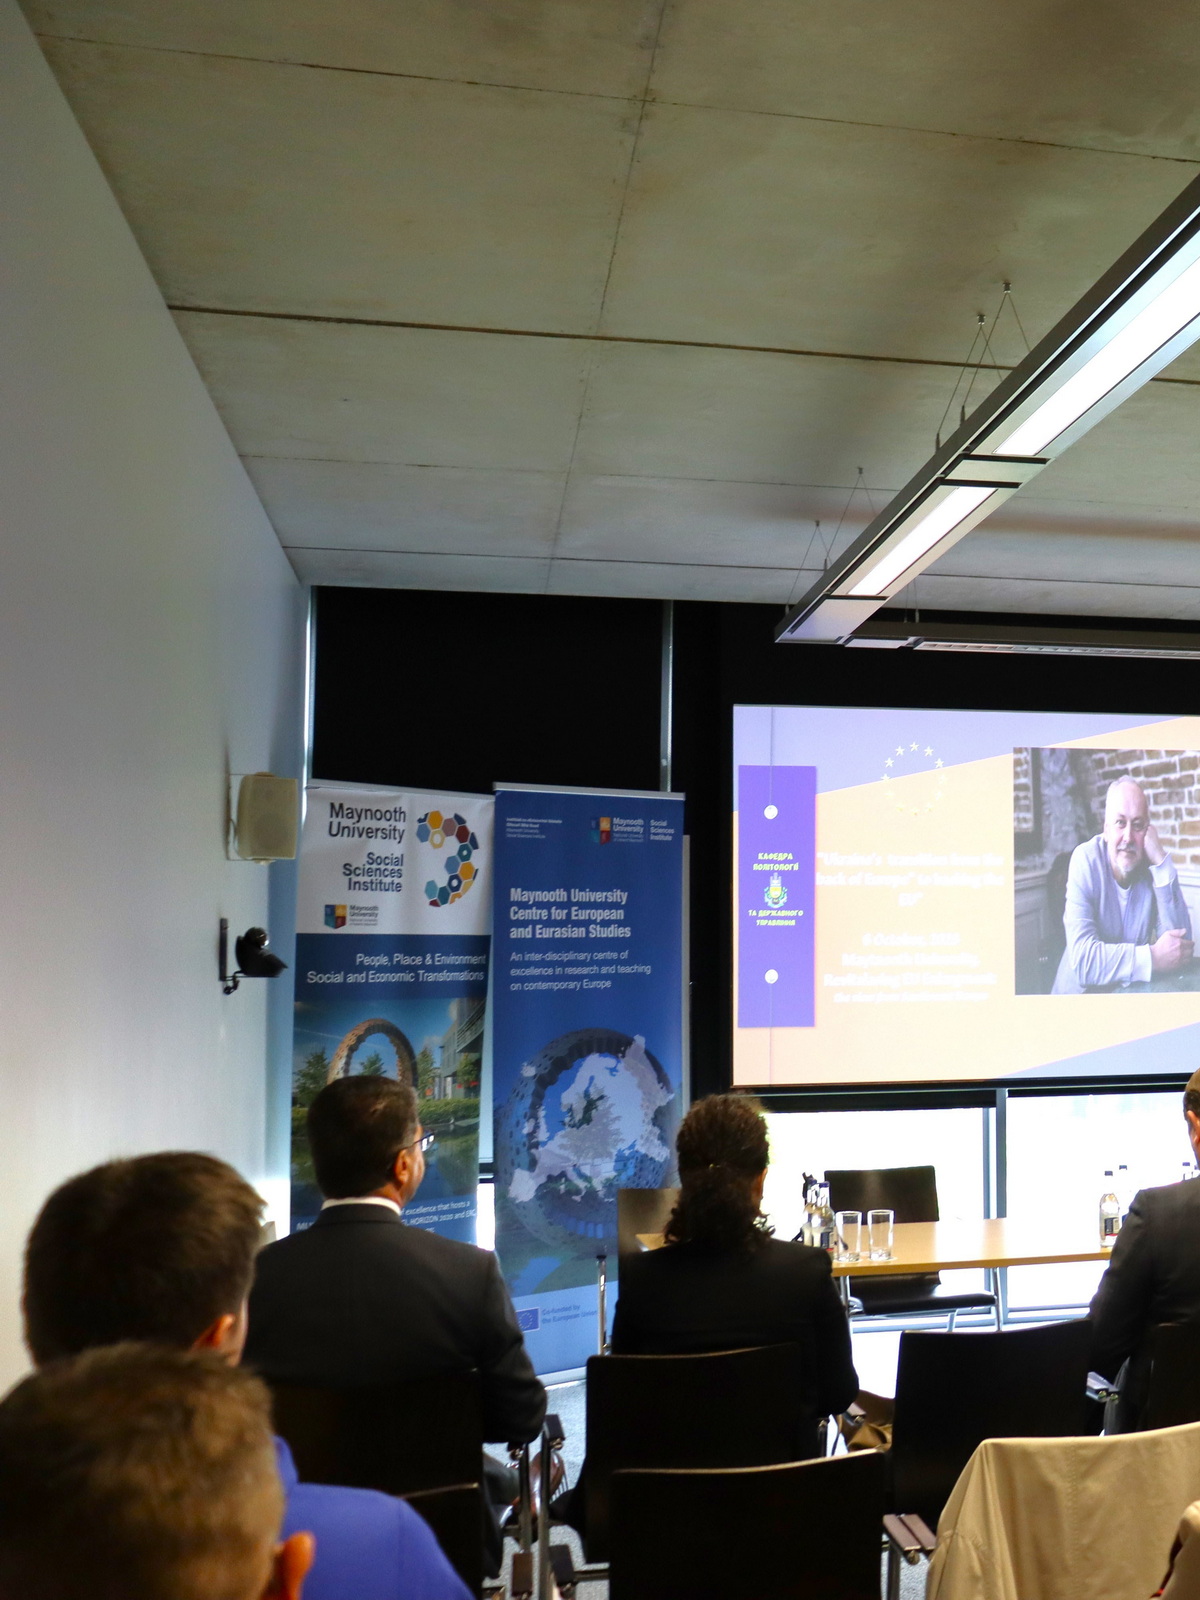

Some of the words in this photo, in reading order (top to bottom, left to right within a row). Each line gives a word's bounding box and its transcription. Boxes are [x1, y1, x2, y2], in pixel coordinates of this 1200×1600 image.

[330, 802, 406, 823] Maynooth
[613, 817, 644, 826] Maynooth
[650, 819, 668, 827] Social
[328, 821, 405, 844] University
[613, 825, 644, 833] University
[650, 826, 675, 834] Sciences
[366, 852, 404, 866] Social
[758, 852, 794, 861] КАФЕДРА
[342, 863, 403, 878] Sciences
[348, 878, 402, 892] Institute
[510, 887, 568, 904] Maynooth
[570, 888, 628, 905] University
[510, 906, 548, 920] Centre
[551, 906, 568, 920] for
[570, 906, 624, 922] European
[510, 924, 532, 938] and
[535, 924, 586, 938] Eurasian
[588, 924, 632, 938] Studies
[355, 953, 391, 967] People,
[392, 953, 422, 966] Place
[425, 953, 432, 965] &
[434, 953, 486, 965] Environment
[510, 952, 523, 961] An
[524, 951, 592, 962] inter-disciplinary
[592, 951, 618, 960] centre
[620, 950, 629, 960] of
[306, 971, 344, 984] Social
[346, 971, 366, 983] and
[368, 970, 416, 983] Economic
[417, 969, 484, 982] Transformations
[510, 966, 554, 976] excellence
[555, 966, 563, 975] in
[564, 965, 600, 975] research
[600, 965, 616, 974] and
[617, 964, 652, 975] teaching
[510, 982, 522, 991] on
[523, 980, 582, 992] contemporary
[583, 979, 612, 990] Europe
